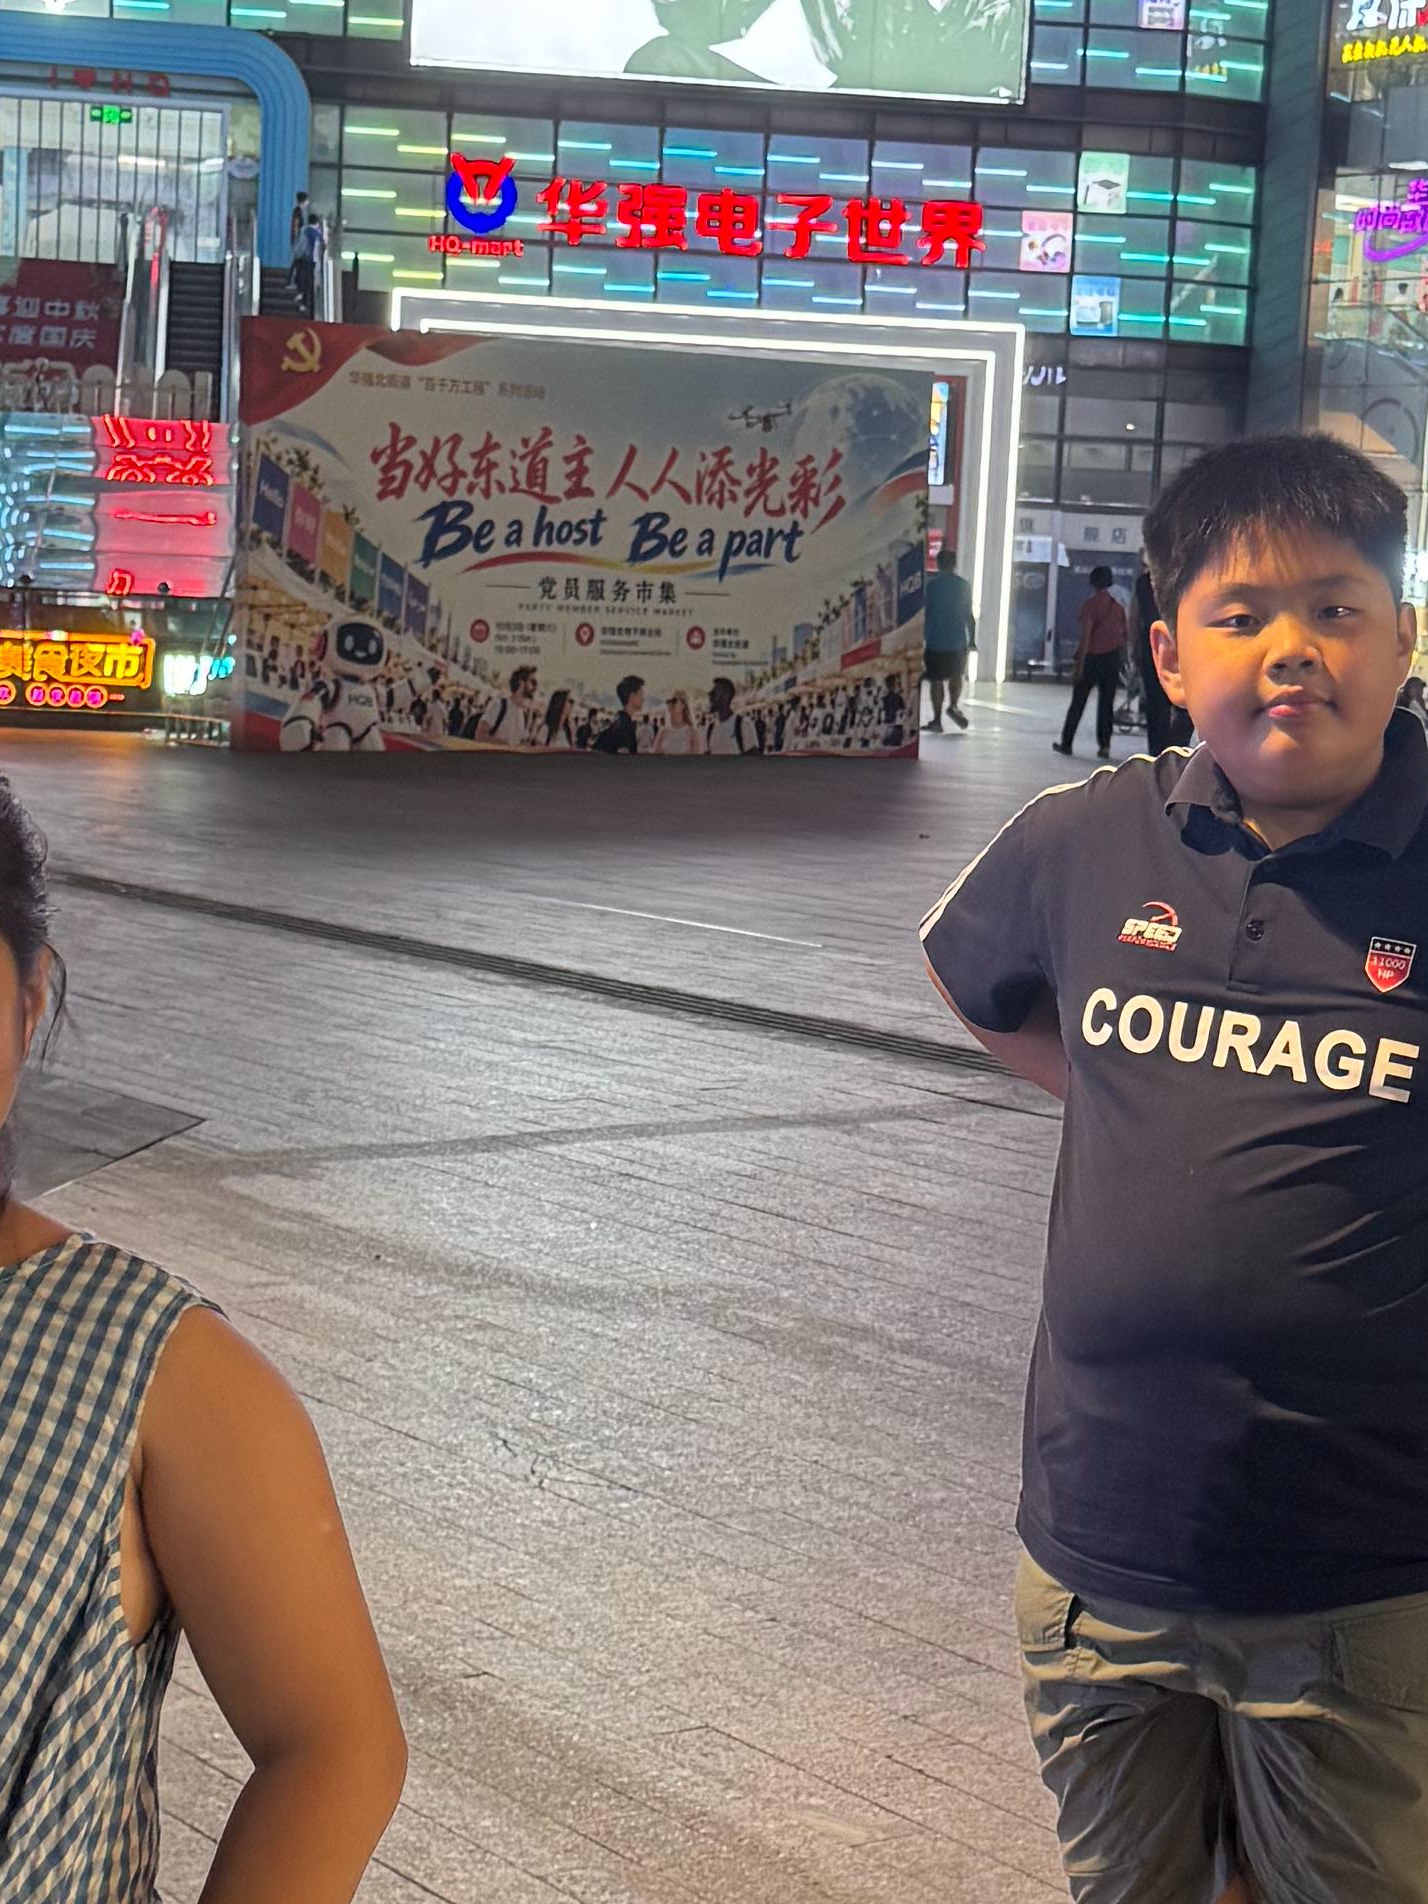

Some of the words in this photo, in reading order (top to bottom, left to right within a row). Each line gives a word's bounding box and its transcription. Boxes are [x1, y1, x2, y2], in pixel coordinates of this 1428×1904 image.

[428, 234, 525, 259] HQ-mart
[535, 178, 988, 268] 华强电子世界
[412, 499, 497, 568] Be
[504, 520, 522, 549] a
[533, 506, 608, 548] host
[624, 511, 690, 566] Be
[695, 528, 715, 556] a
[721, 520, 806, 583] part
[539, 576, 677, 604] 党员服务市集
[1122, 918, 1182, 943] SPEED
[1081, 987, 1421, 1104] COURAGE
